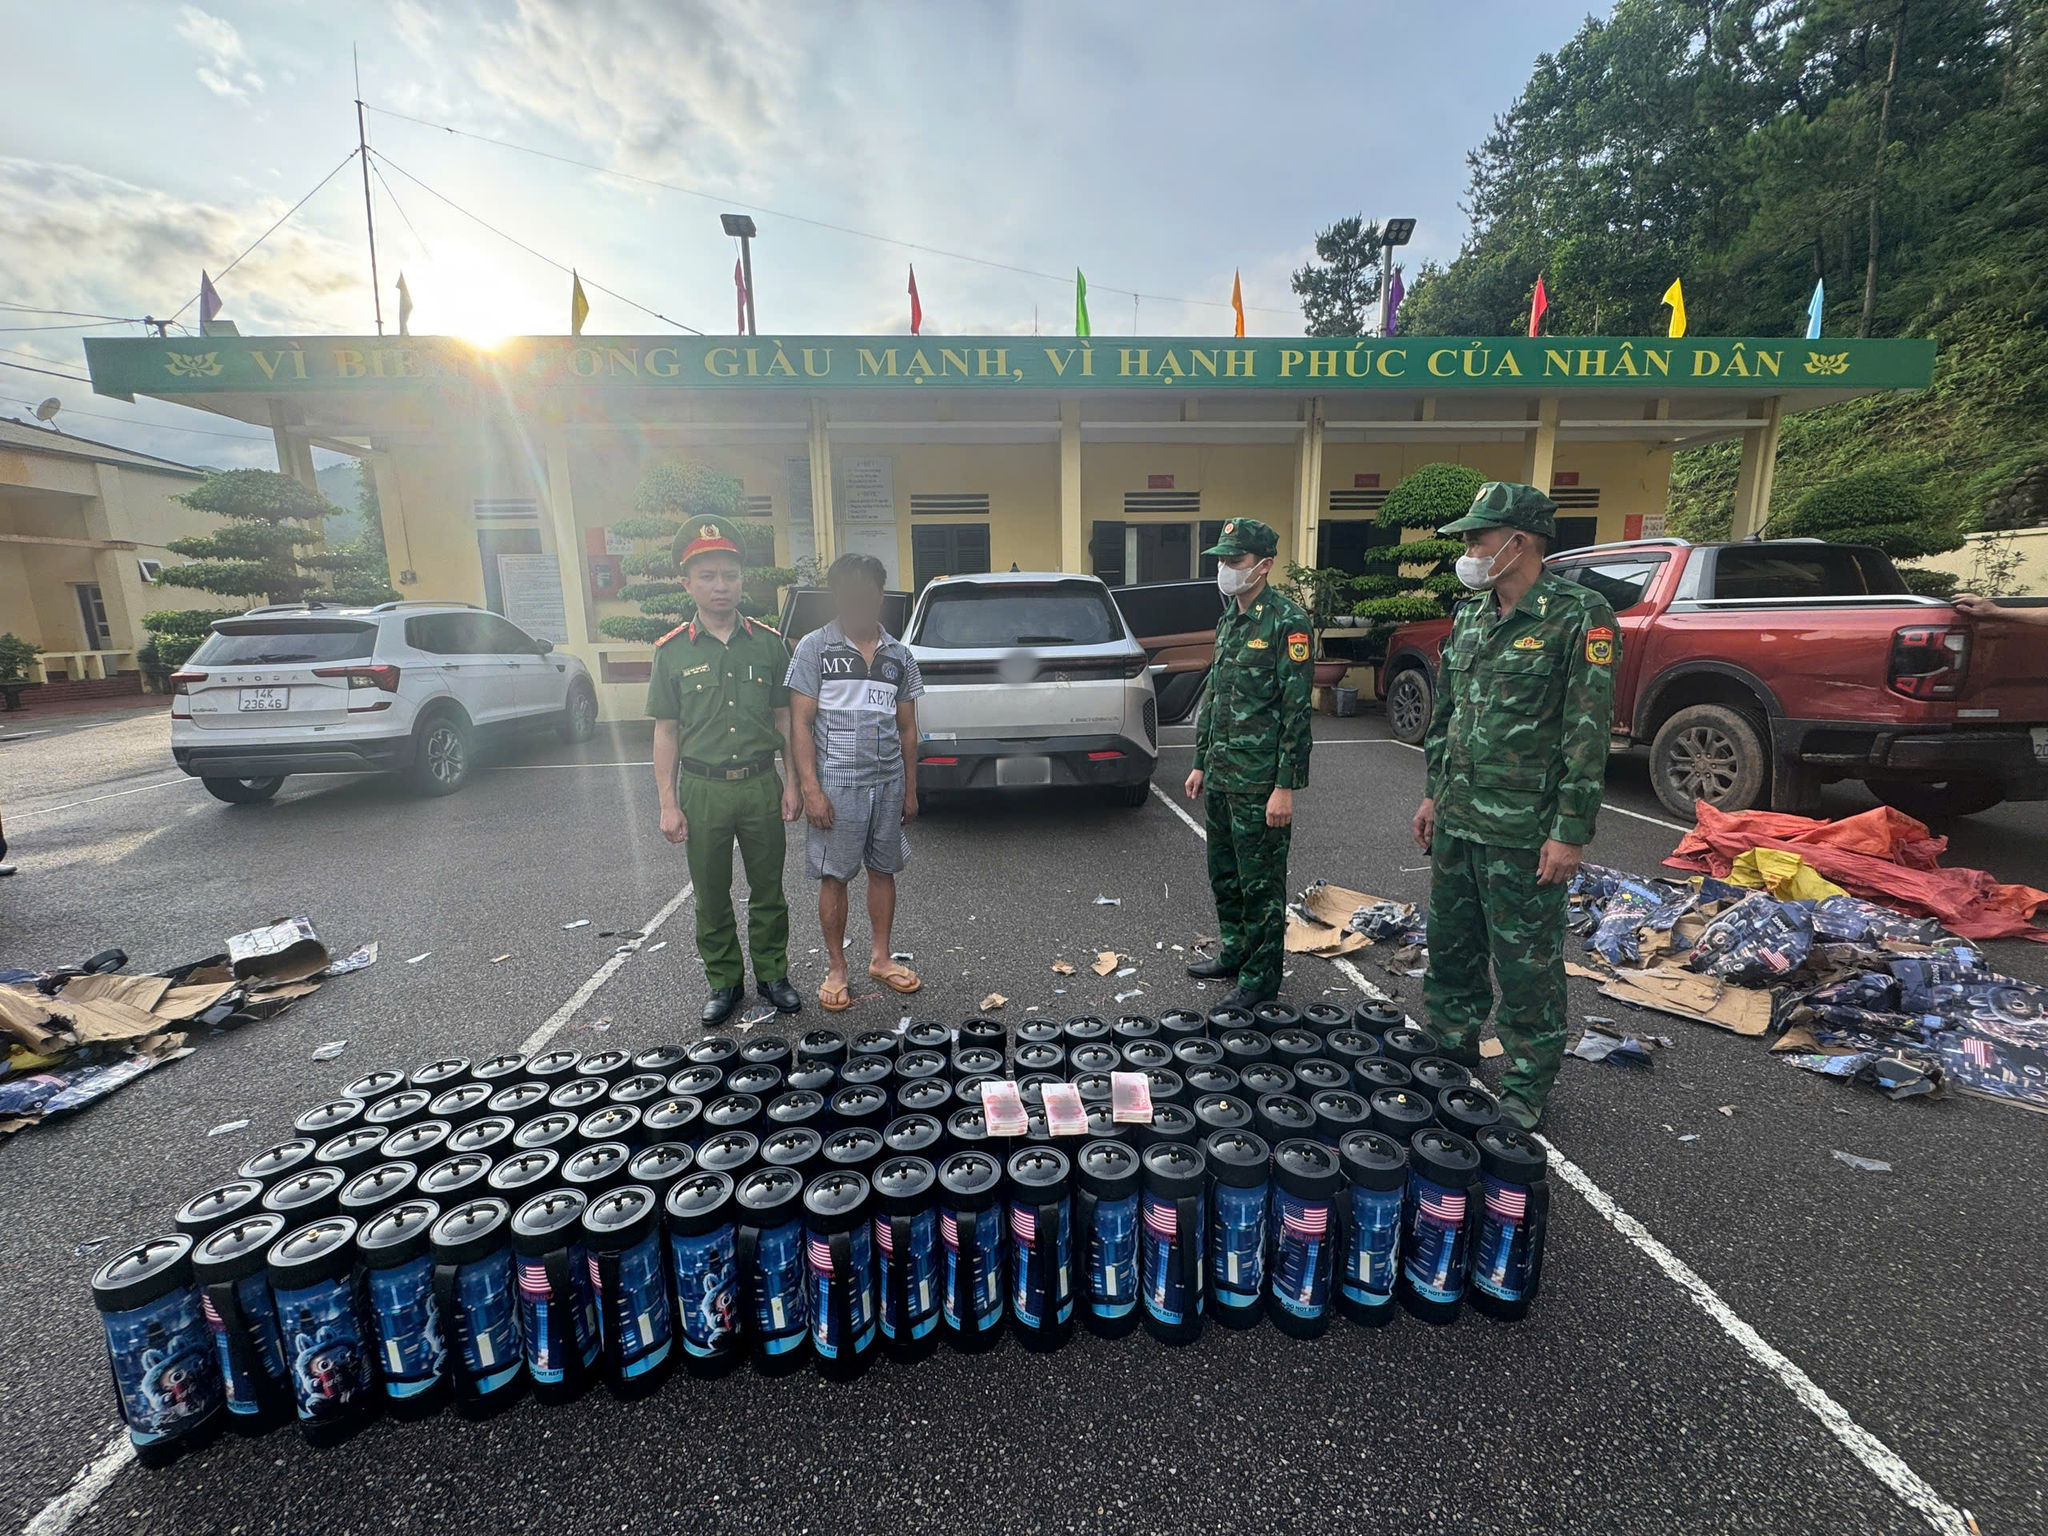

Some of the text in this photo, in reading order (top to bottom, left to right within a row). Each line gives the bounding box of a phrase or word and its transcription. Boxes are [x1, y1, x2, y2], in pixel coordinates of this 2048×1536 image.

[250, 342, 307, 379] VÌ
[703, 340, 834, 377] GIÀU
[856, 346, 1024, 384] MẠNH,
[1043, 340, 1097, 377] VÌ
[1117, 347, 1257, 384] HẠNH
[1277, 340, 1407, 378] PHÚC
[1426, 339, 1523, 378] CỦA
[1544, 340, 1672, 378] NHÂN
[1692, 340, 1784, 378] DÂN
[822, 657, 855, 674] MY
[254, 689, 273, 699] 14K
[244, 699, 282, 709] 236.46
